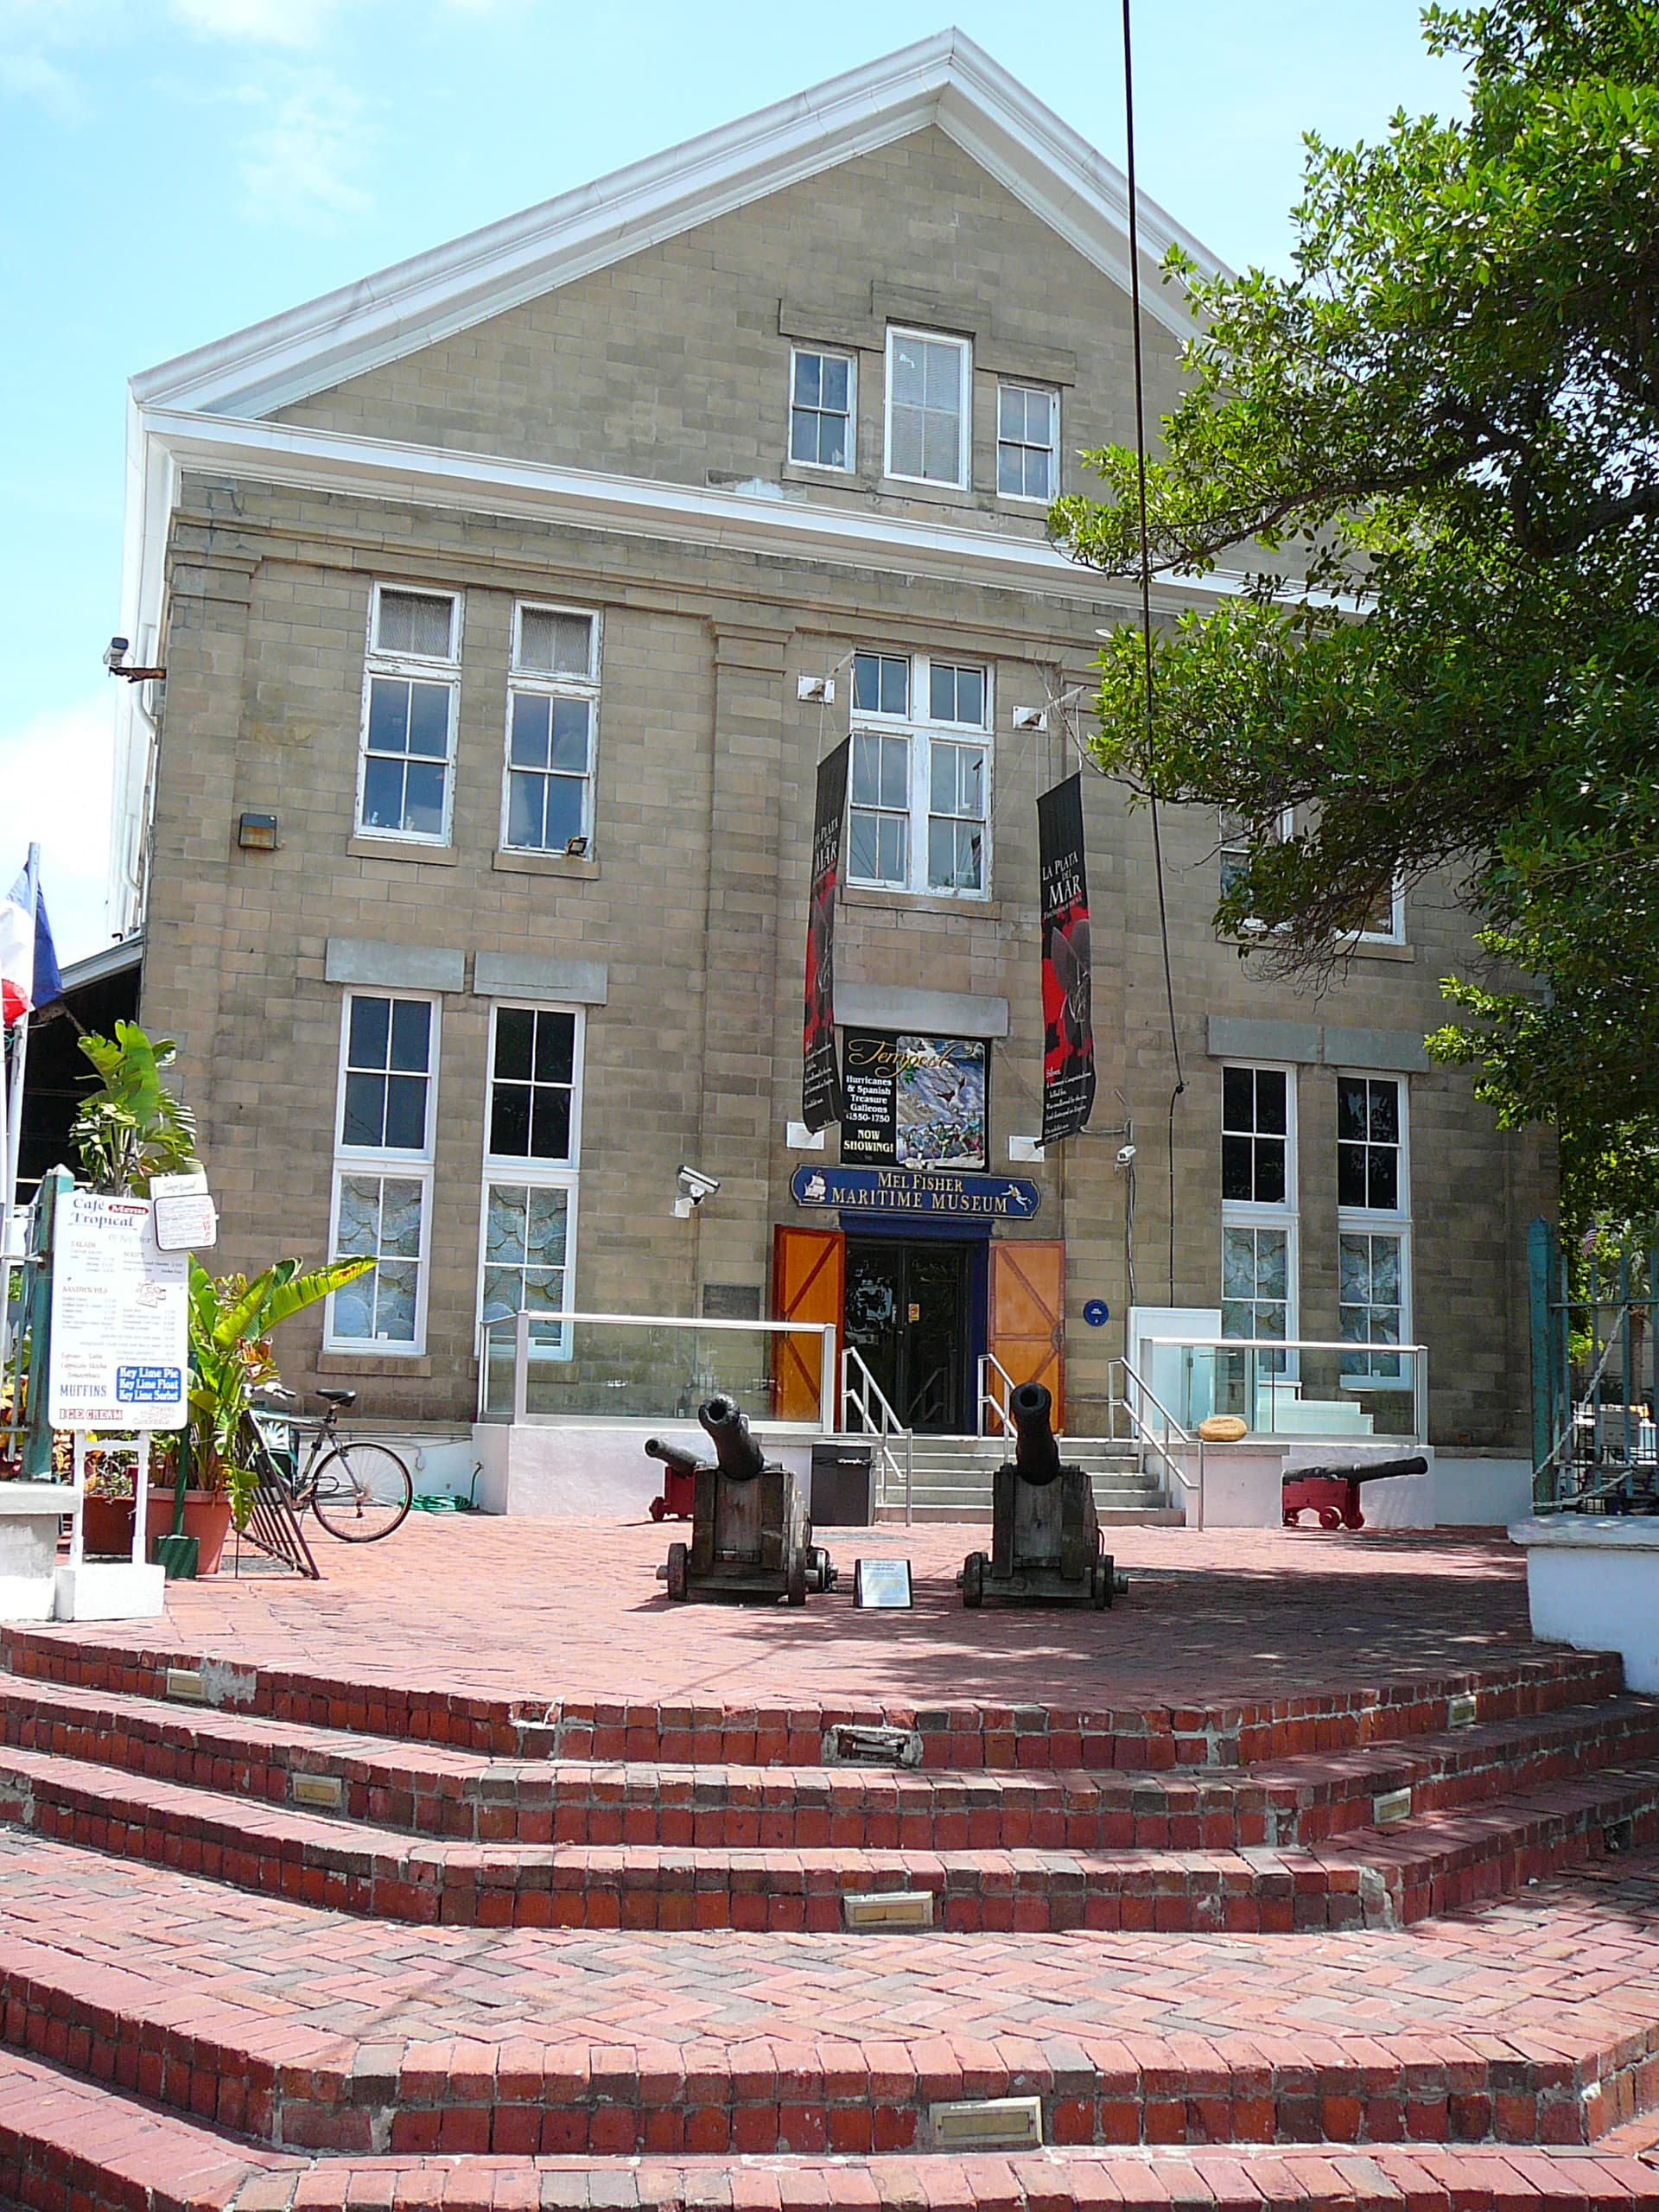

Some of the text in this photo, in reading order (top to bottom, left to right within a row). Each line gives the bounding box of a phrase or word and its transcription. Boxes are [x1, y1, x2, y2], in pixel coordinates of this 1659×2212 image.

[1042, 851, 1078, 880] LA PLATA
[1049, 874, 1082, 908] MAR
[848, 1039, 974, 1078] Tempest
[846, 1075, 892, 1086] Hurricanes
[847, 1084, 892, 1096] & Spanish
[850, 1094, 888, 1104] Treasure
[850, 1103, 888, 1114] Galleons
[857, 1129, 880, 1140] NOW
[843, 1140, 894, 1154] SHOWING!
[878, 1172, 963, 1192] MEL FISHER
[73, 1198, 145, 1215] Café Menu
[831, 1187, 1007, 1213] MARITIME MUSEUM
[70, 1211, 134, 1229] Tropical
[119, 1368, 179, 1378] Key Lime Pie
[60, 1383, 107, 1396] MUFFINS
[119, 1379, 179, 1390] Key Lime Float
[119, 1389, 178, 1401] Key Lime Sorbet
[59, 1408, 85, 1420] ICE
[86, 1409, 123, 1421] CREAM
